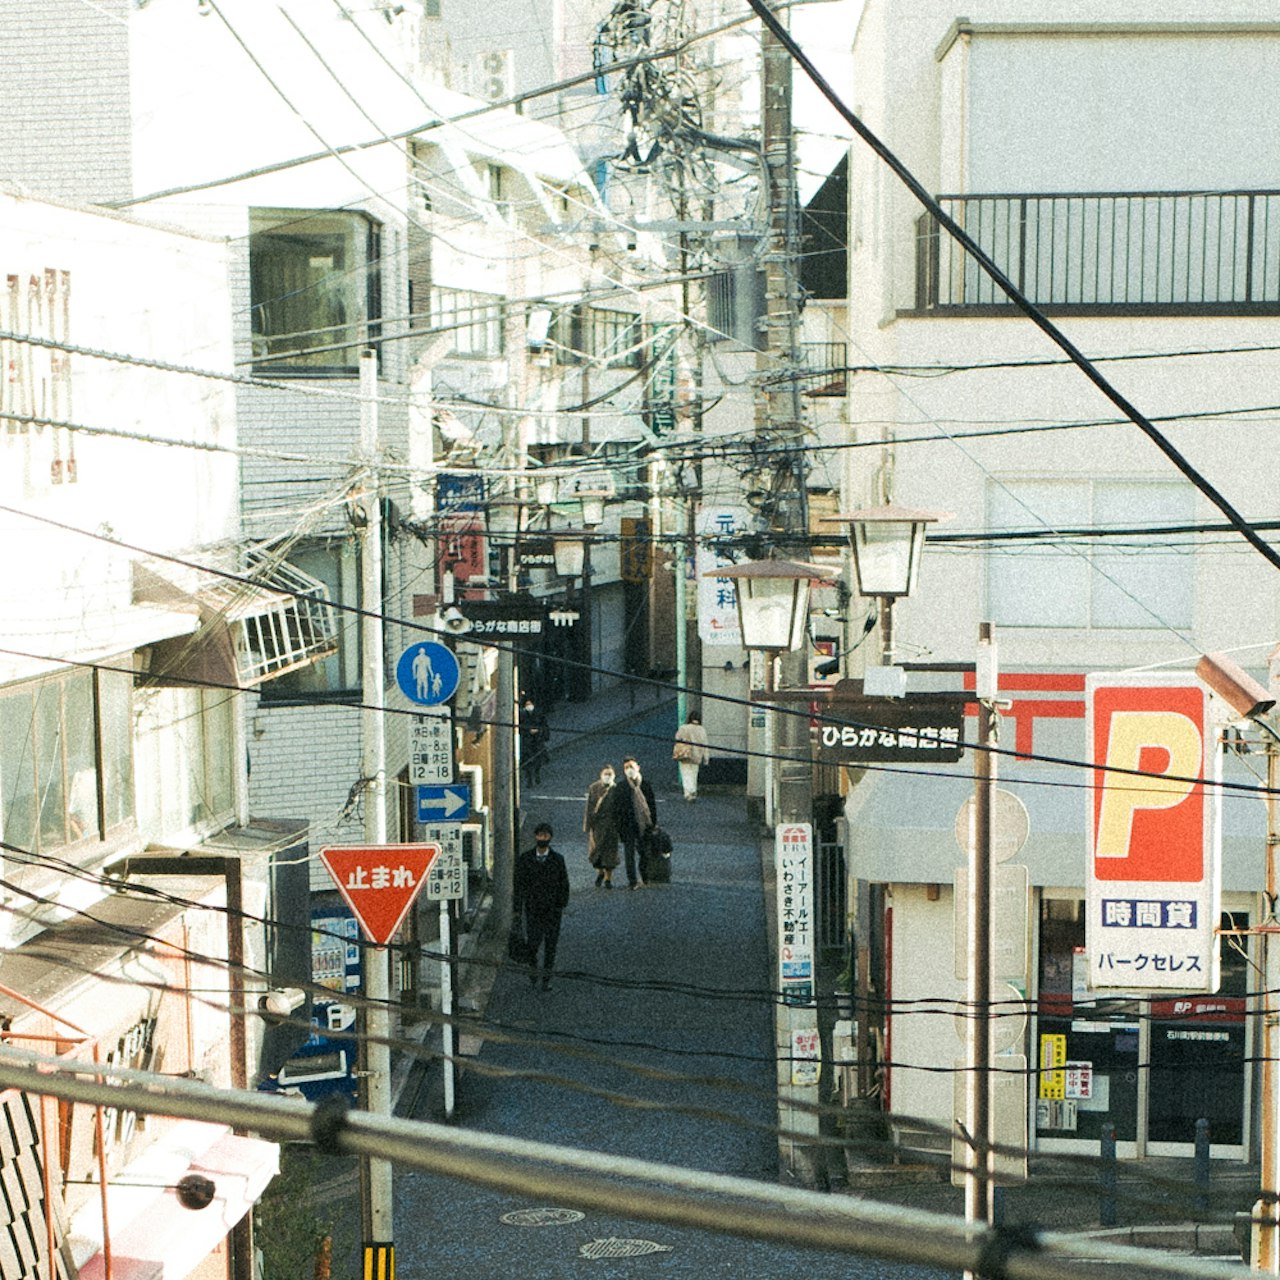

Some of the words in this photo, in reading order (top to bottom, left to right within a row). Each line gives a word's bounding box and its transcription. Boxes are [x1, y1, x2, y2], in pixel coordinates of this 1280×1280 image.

[1096, 711, 1203, 859] P
[346, 866, 417, 890] 止まれ
[430, 881, 461, 894] 18-12
[782, 858, 796, 945] いわさき不動産
[1105, 901, 1194, 929] 時間貸
[1098, 952, 1203, 973] パークセレス
